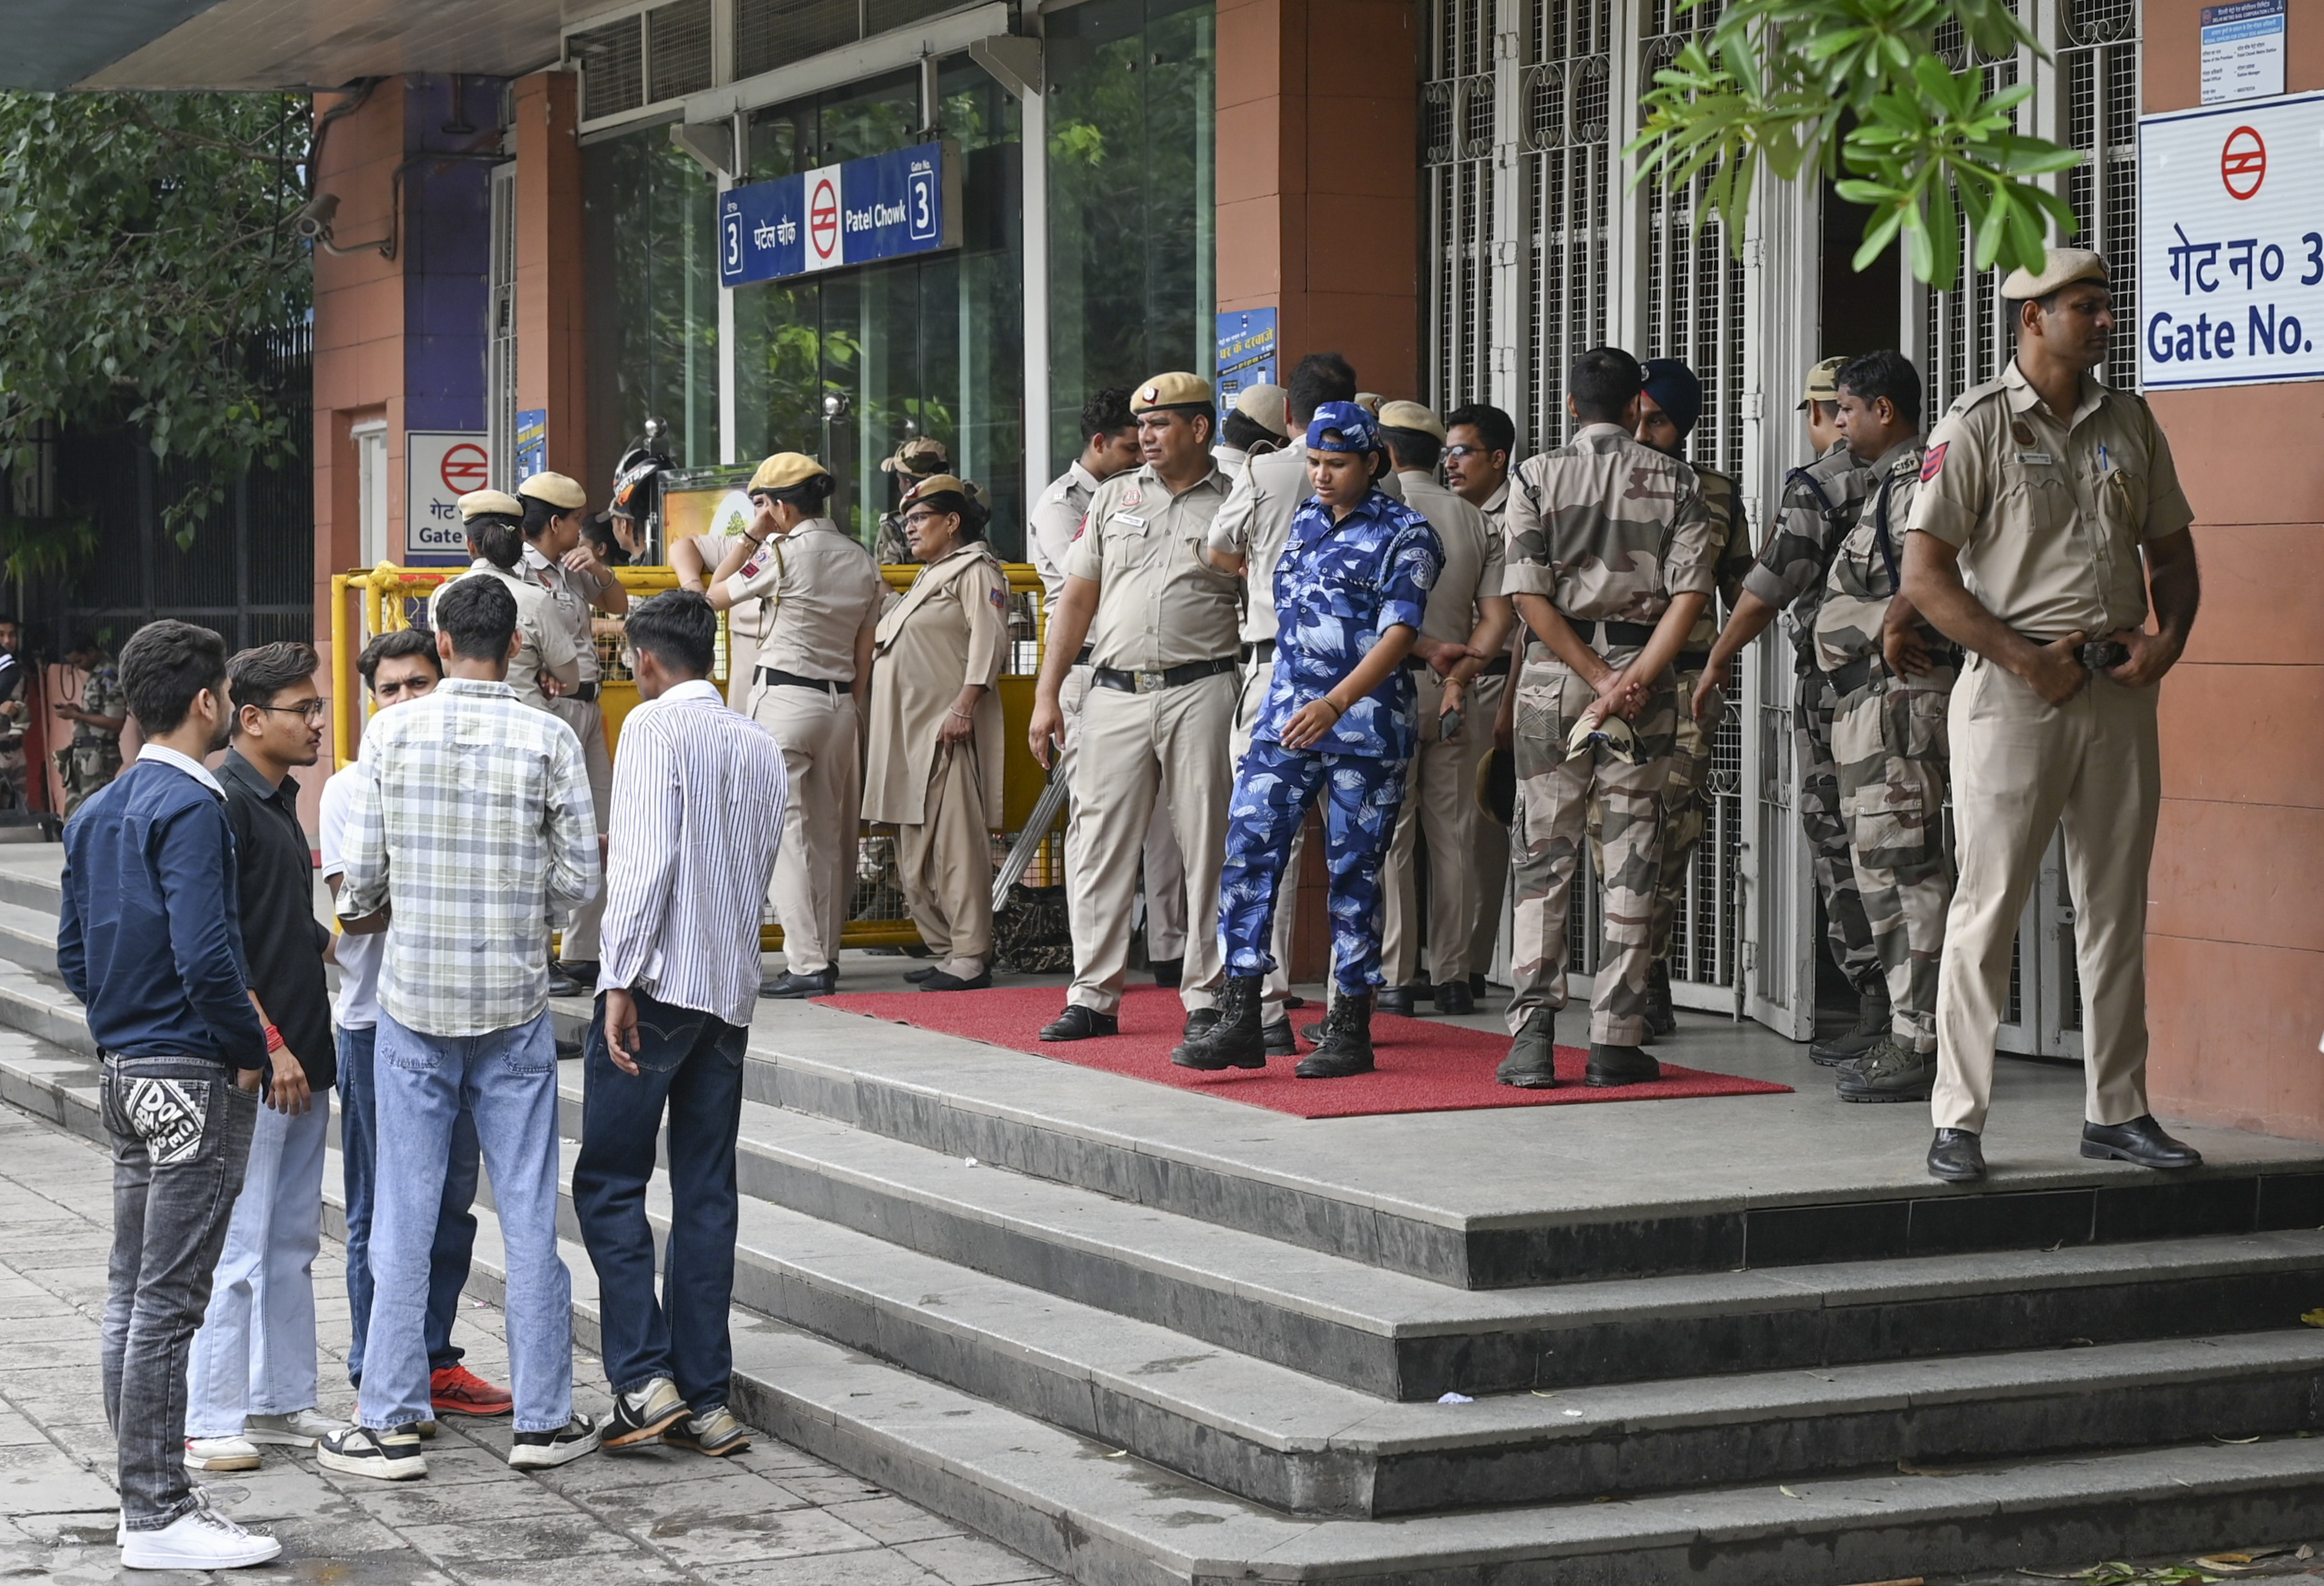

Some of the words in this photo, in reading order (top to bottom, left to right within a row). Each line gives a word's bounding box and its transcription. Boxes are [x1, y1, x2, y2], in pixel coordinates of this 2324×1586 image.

[911, 161, 922, 172] Gate
[846, 205, 872, 233] Patel
[874, 199, 906, 228] Chowk
[915, 182, 929, 229] 3
[728, 223, 738, 265] 3
[753, 219, 776, 250] पटेल
[778, 214, 796, 245] चौक
[2168, 222, 2221, 295] गेट
[2300, 232, 2324, 286] 3
[2148, 311, 2235, 363] Gate
[2248, 304, 2312, 356] No.
[430, 498, 456, 519] गेट
[419, 527, 462, 543] Gate
